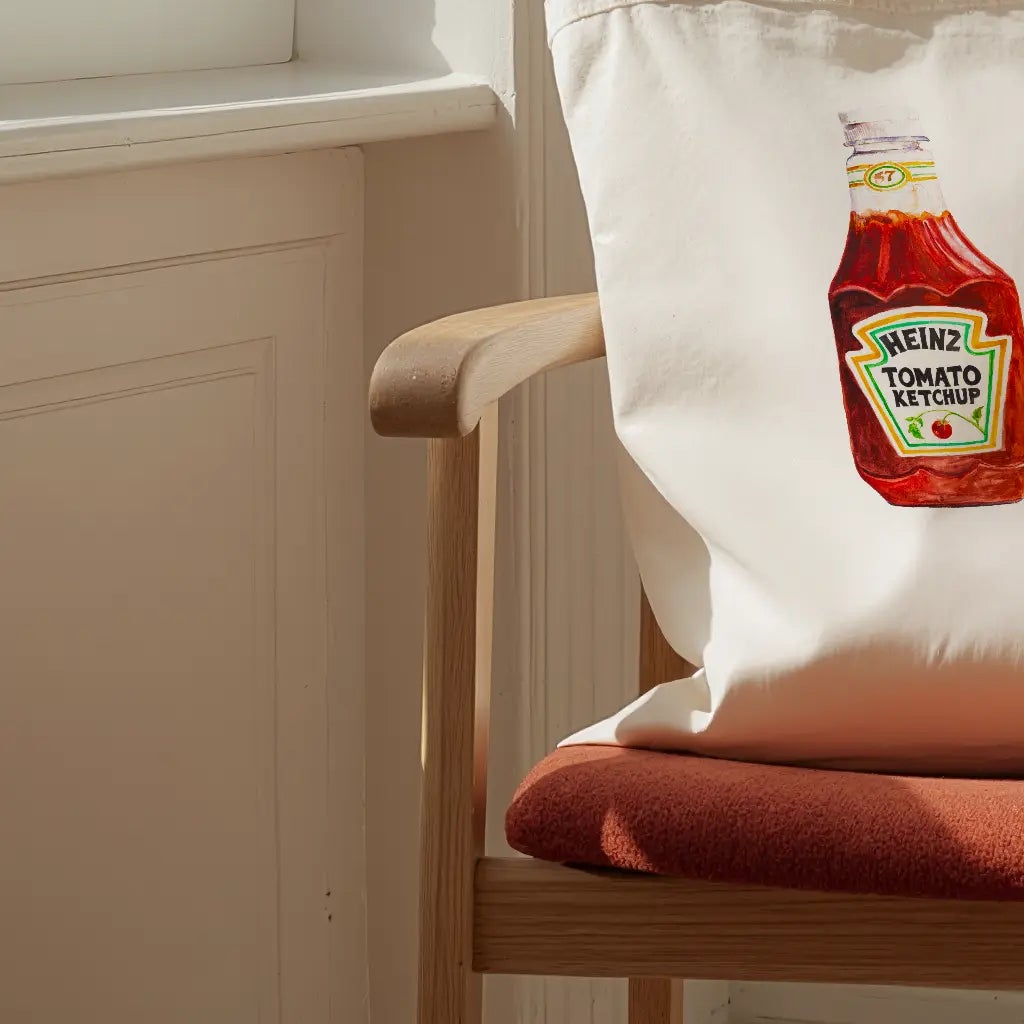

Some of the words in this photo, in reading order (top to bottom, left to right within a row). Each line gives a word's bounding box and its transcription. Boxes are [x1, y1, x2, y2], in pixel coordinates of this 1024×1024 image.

[879, 327, 962, 357] HEINZ
[881, 365, 982, 388] TOMATO
[892, 388, 981, 408] KETCHUP
